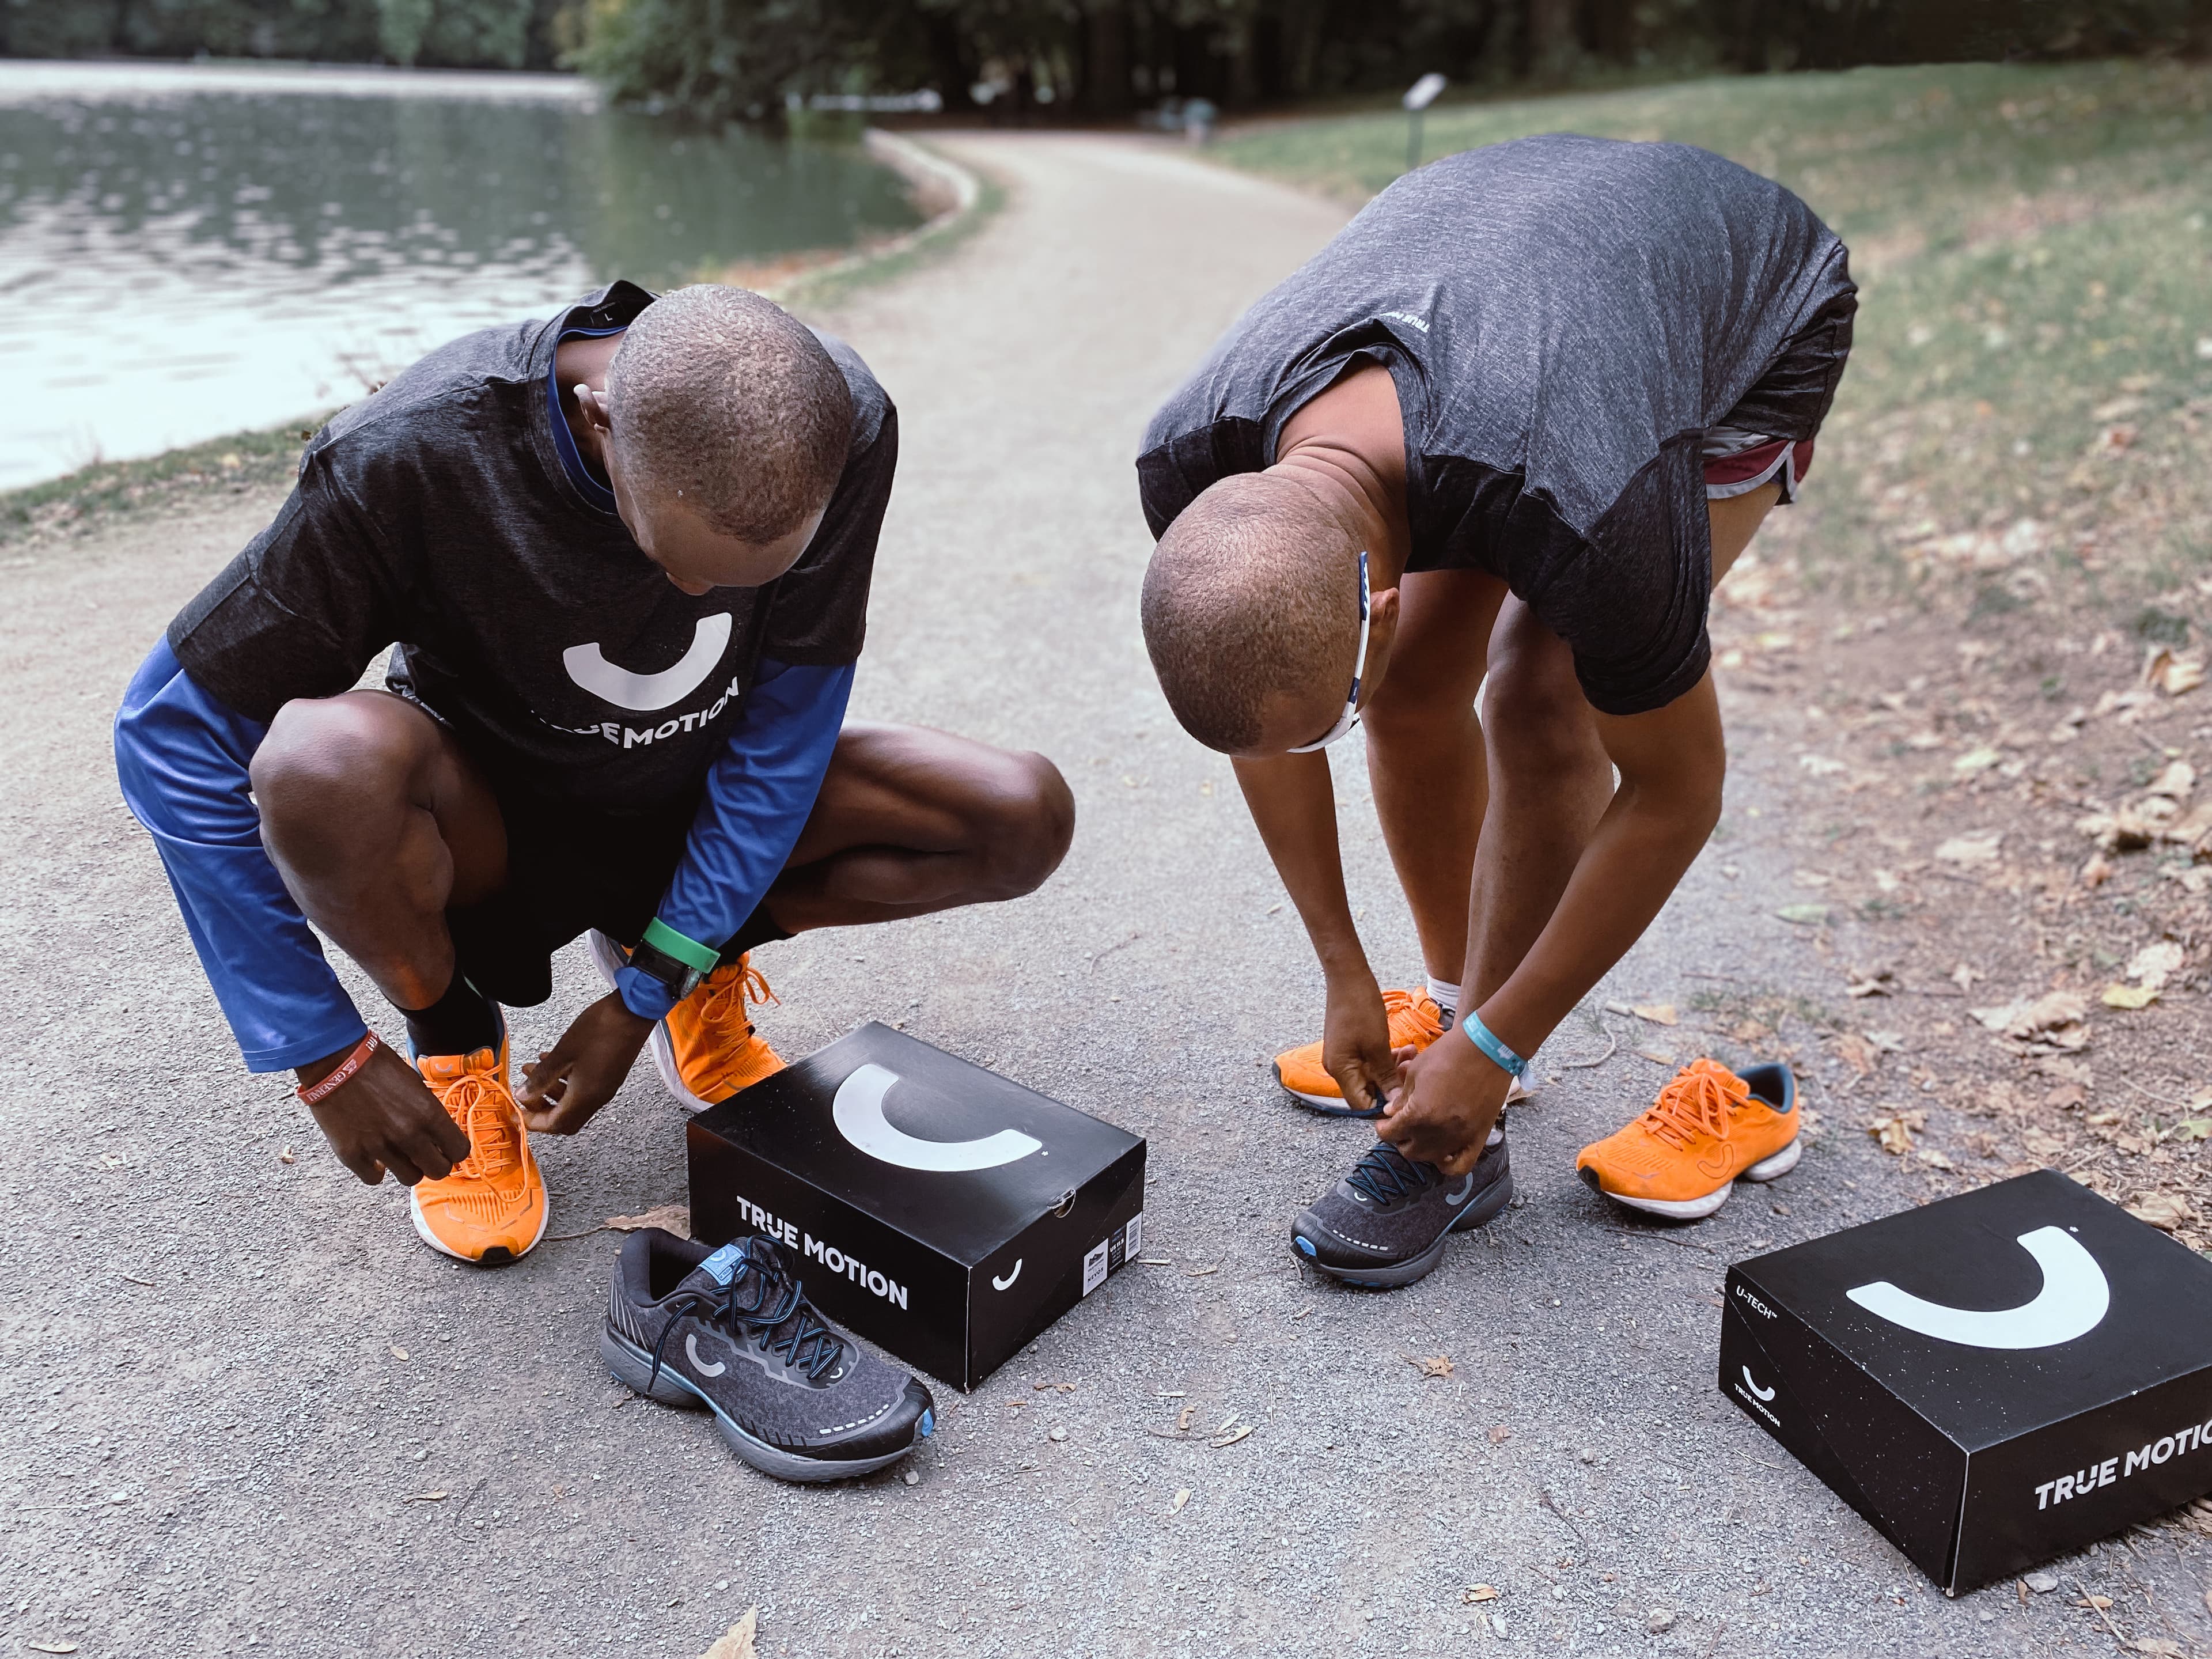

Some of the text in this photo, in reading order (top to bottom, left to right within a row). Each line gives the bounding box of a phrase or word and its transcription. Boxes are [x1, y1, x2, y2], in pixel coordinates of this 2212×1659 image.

[604, 313, 613, 321] L
[624, 676, 739, 749] MOTION
[306, 1071, 346, 1101] GENERALI
[736, 1195, 908, 1310] TRUE MOTION
[1734, 1383, 1781, 1428] TRUE MOTION
[2035, 1456, 2119, 1510] TRUE
